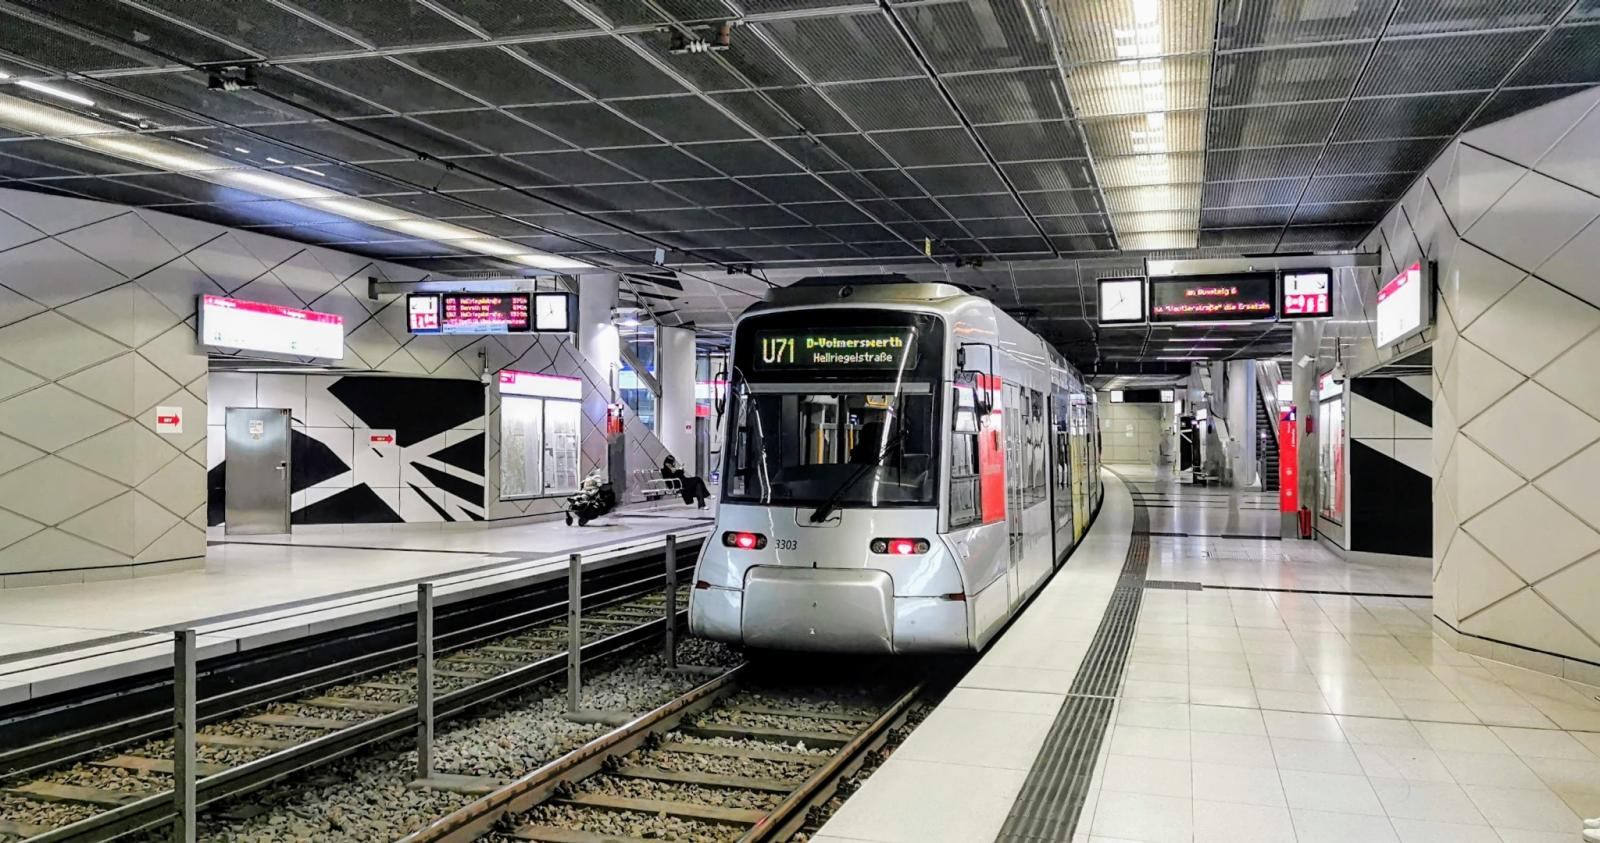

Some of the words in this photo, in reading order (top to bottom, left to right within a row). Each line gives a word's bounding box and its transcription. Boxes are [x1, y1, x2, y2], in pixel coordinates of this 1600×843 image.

[762, 338, 796, 363] U71
[806, 337, 902, 348] D-Volmerswerth
[813, 352, 893, 364] Hellriegelstraße
[774, 539, 797, 550] 3303
